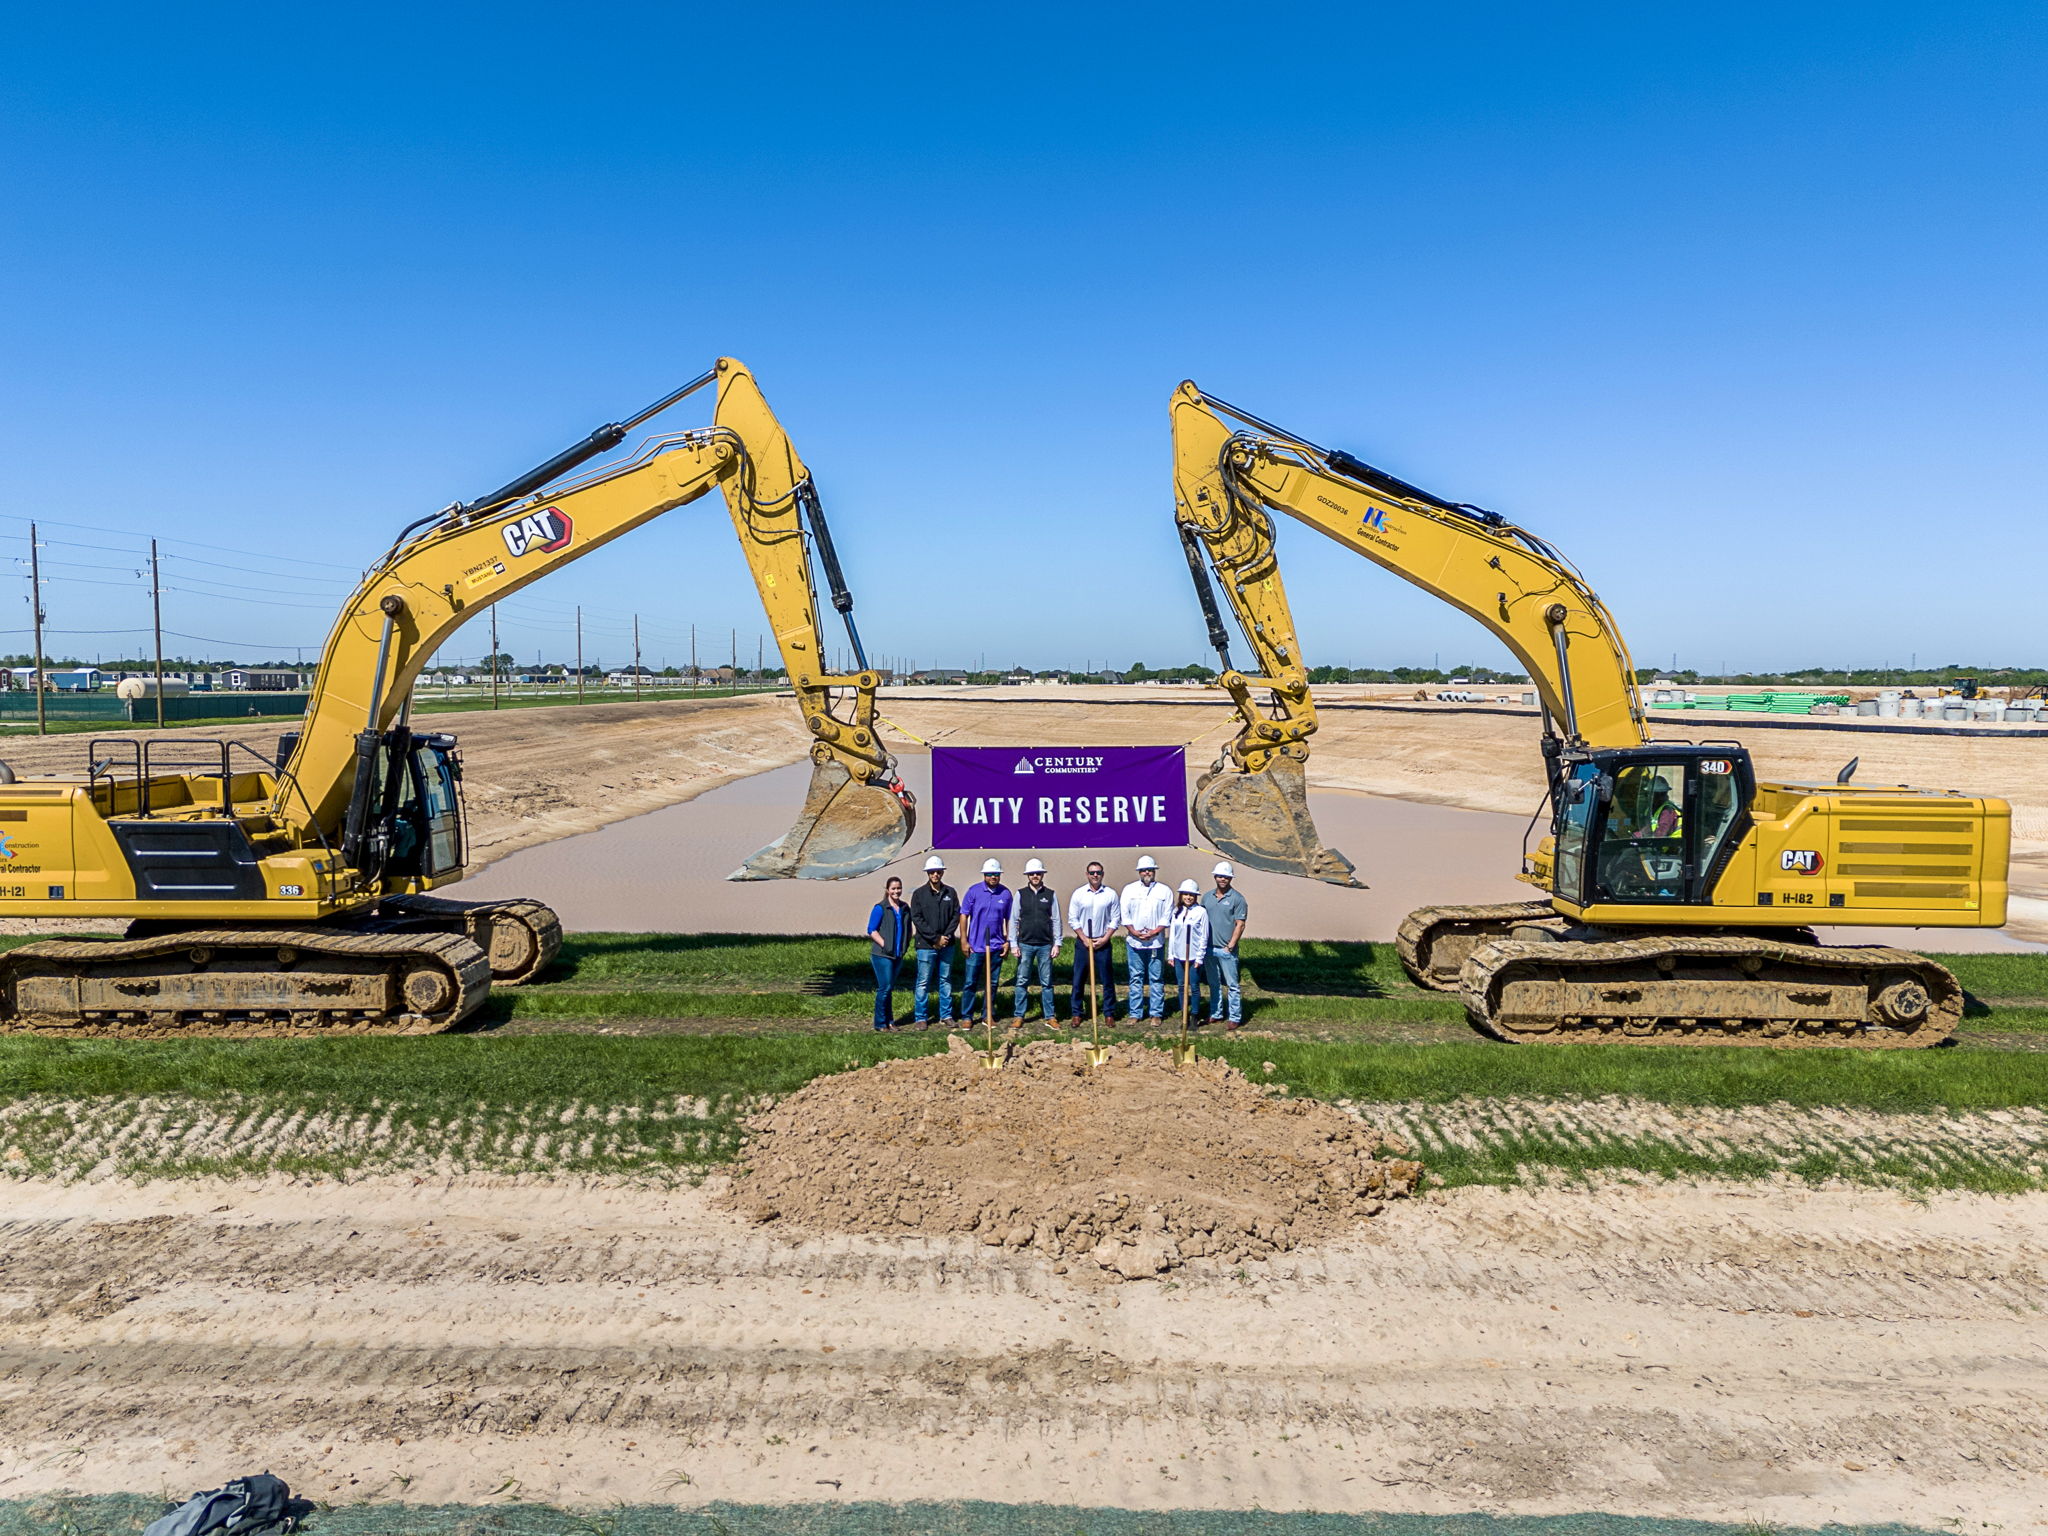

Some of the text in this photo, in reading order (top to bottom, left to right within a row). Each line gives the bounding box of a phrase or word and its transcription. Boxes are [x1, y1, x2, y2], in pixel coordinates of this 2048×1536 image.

[502, 509, 557, 557] CAT
[1356, 527, 1400, 552] General Contractor
[1034, 757, 1104, 767] CENTURY
[1701, 761, 1725, 774] 340
[953, 796, 1167, 824] KATY RESERVE
[1781, 850, 1815, 870] CAT
[7, 863, 41, 874] Contractor
[280, 885, 300, 896] 336
[1782, 893, 1814, 905] H-182
